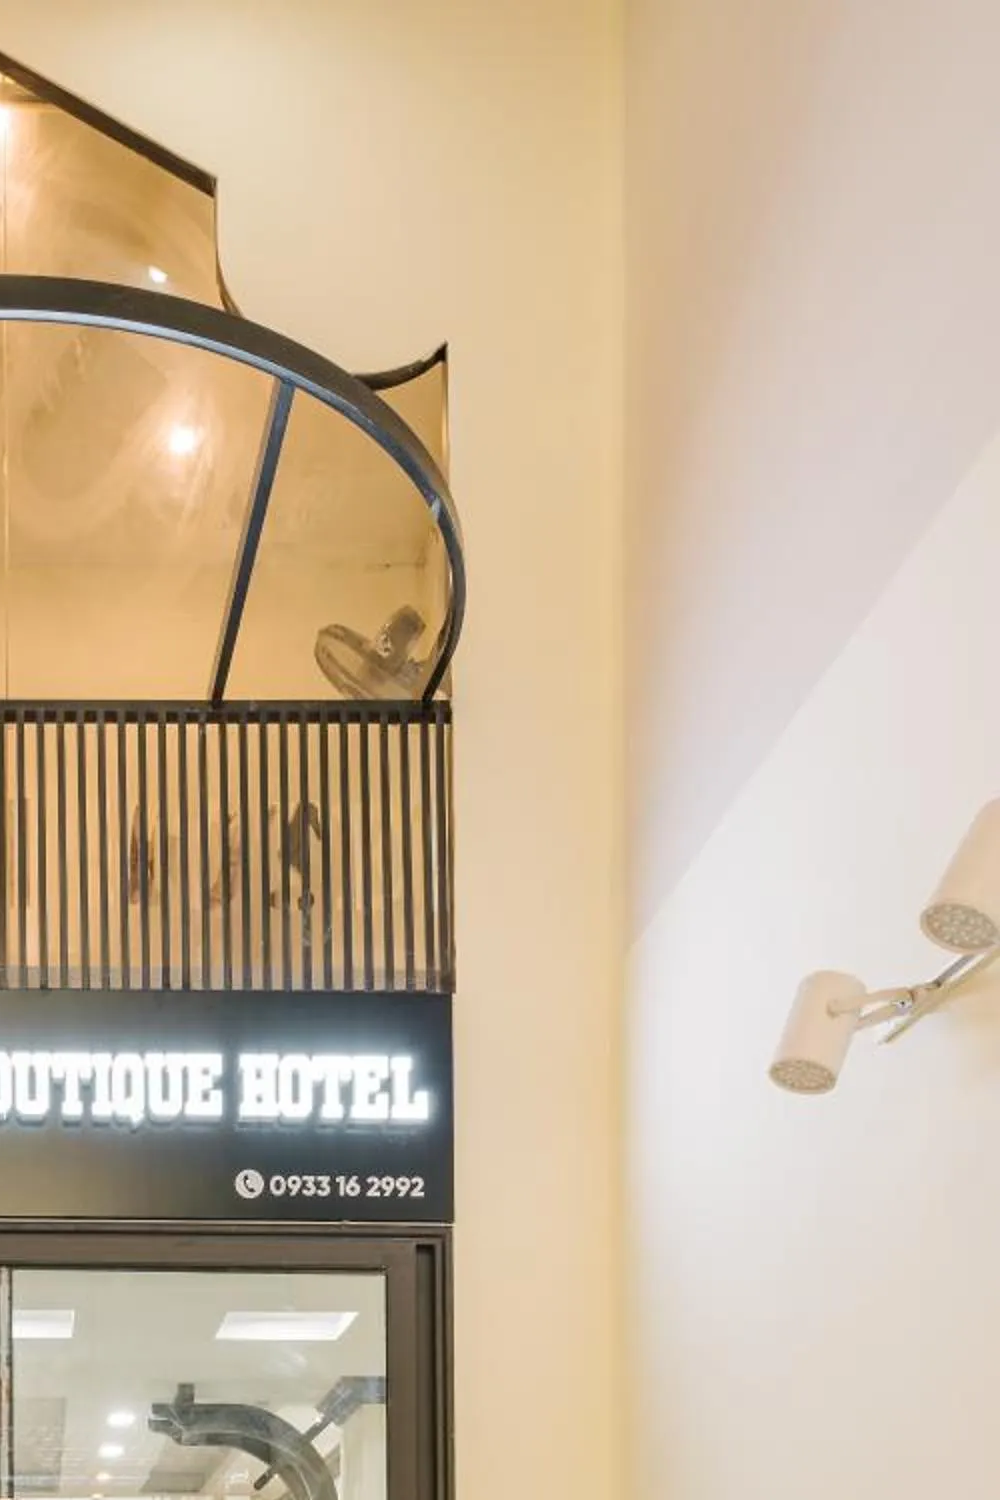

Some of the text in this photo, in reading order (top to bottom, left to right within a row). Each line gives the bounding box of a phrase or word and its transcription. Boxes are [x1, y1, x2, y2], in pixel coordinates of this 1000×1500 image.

[238, 1053, 430, 1121] HOTEL
[269, 1175, 425, 1198] 0933 16 2992
